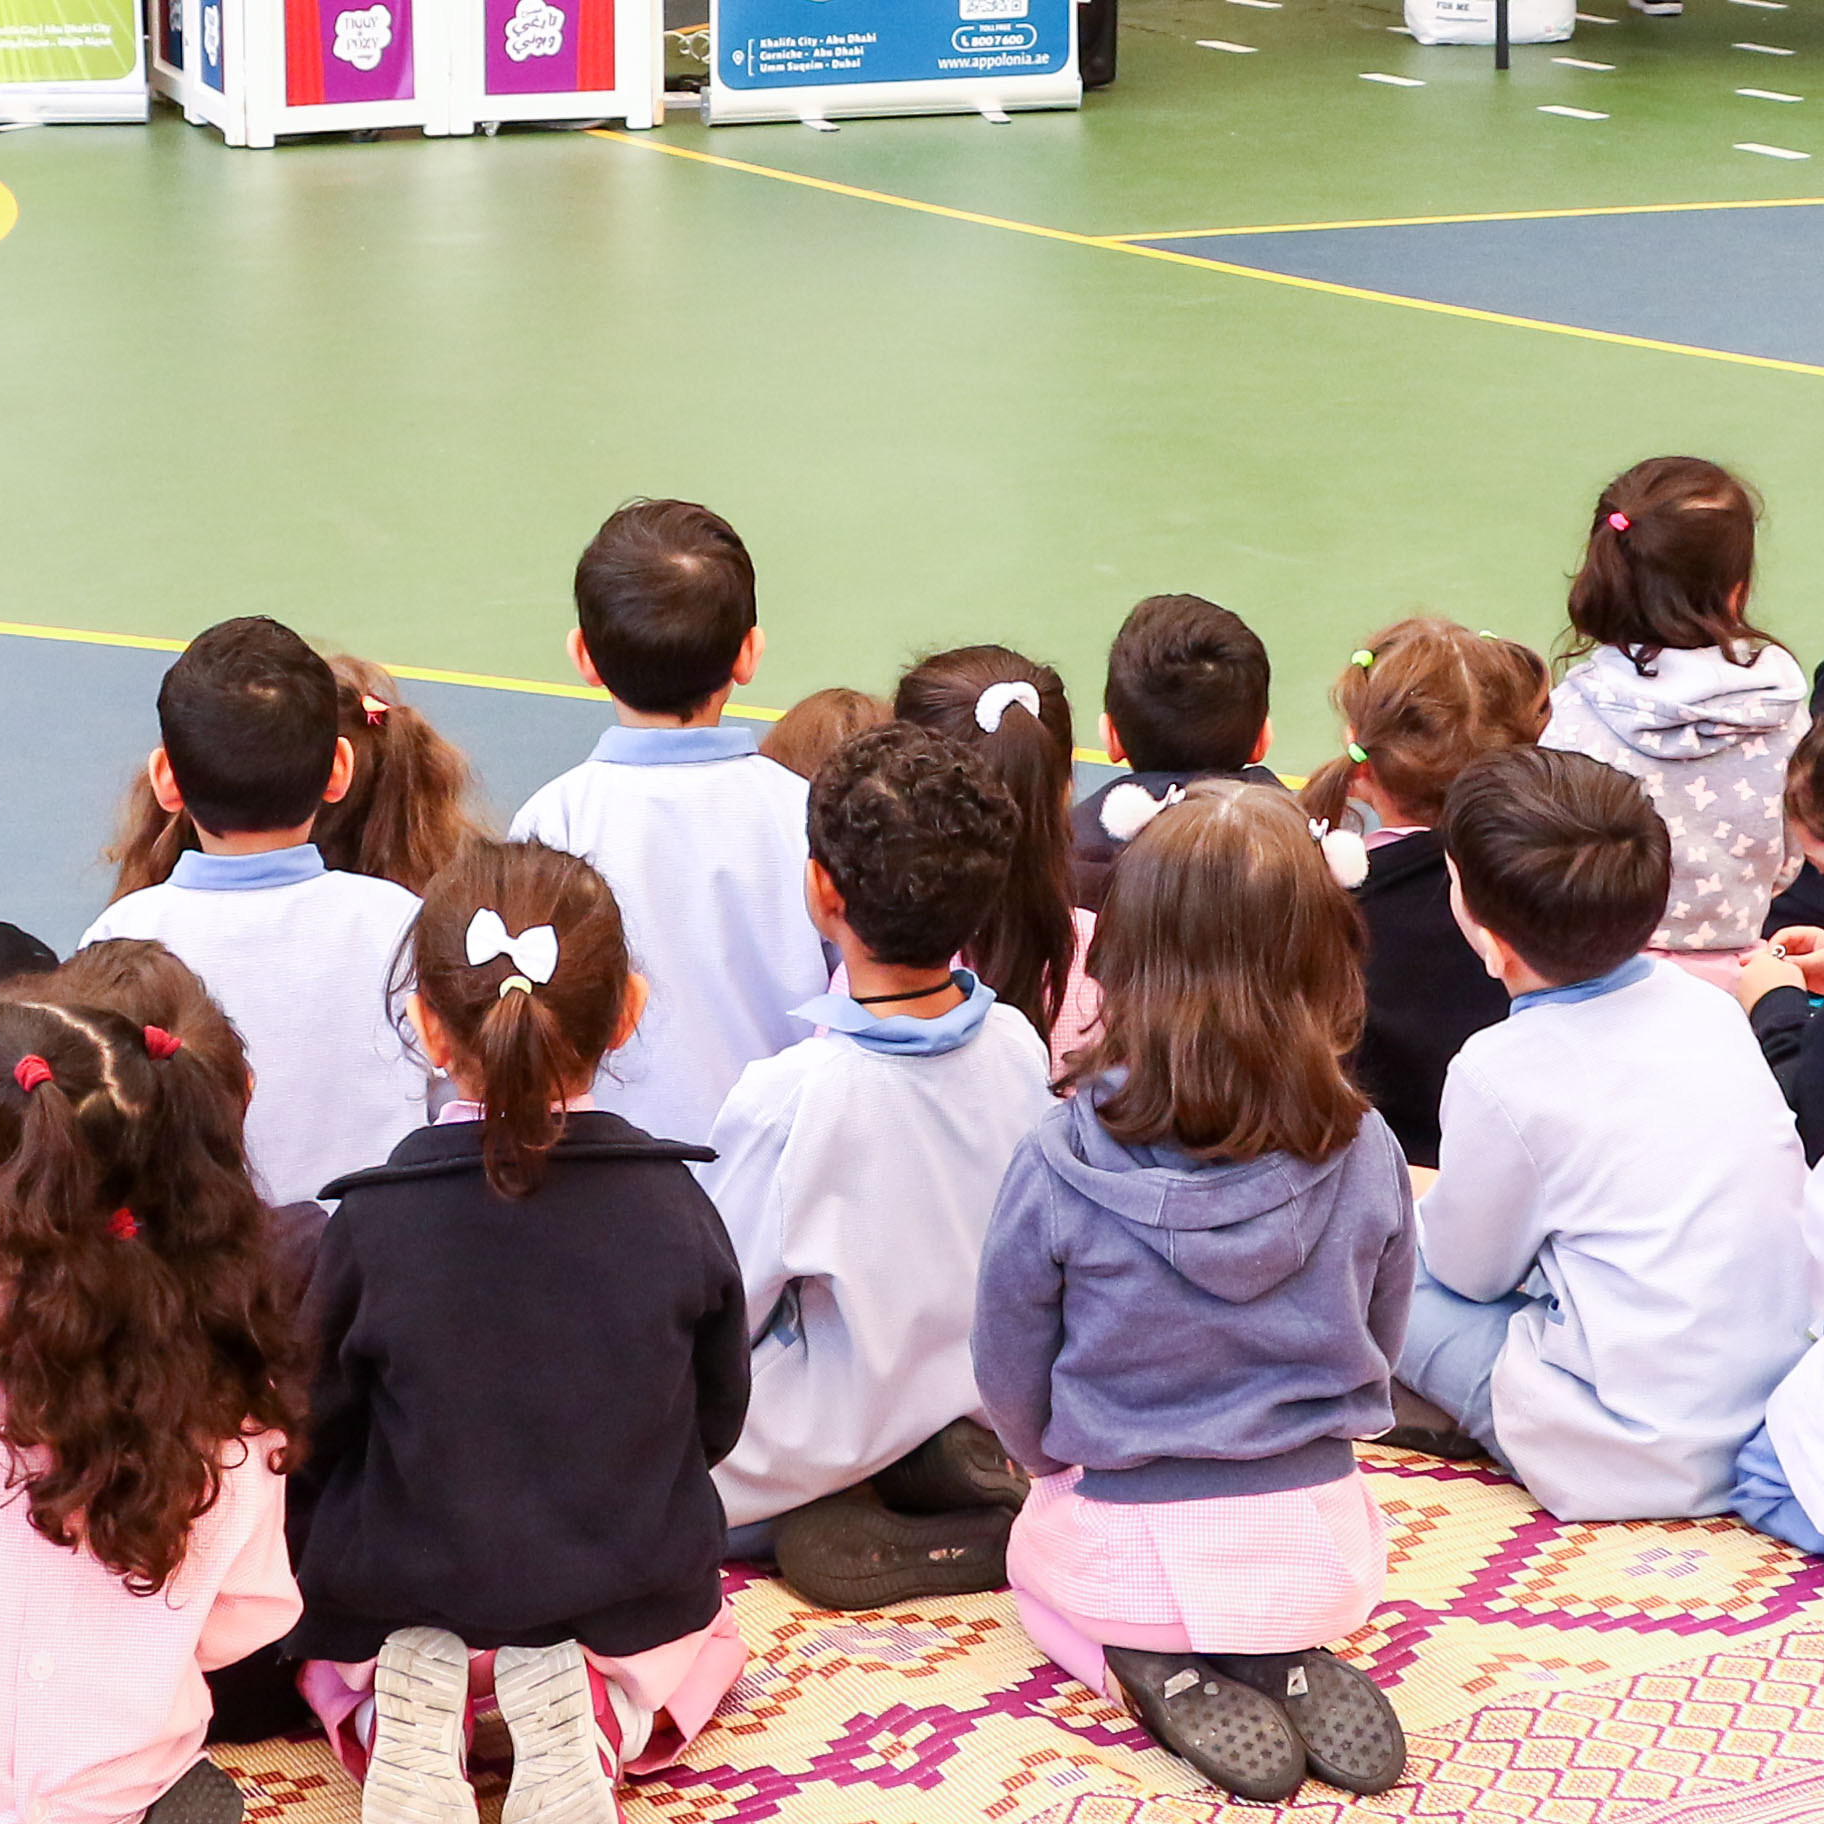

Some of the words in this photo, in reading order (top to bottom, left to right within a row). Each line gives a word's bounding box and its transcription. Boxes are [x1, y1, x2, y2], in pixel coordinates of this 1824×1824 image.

[759, 37, 797, 49] Khalifa
[798, 36, 819, 49] City
[825, 35, 846, 46] Abu
[847, 32, 877, 44] Dhabi
[759, 49, 803, 62] Corniche
[813, 47, 834, 58] Abu
[835, 45, 865, 57] Dhabi
[938, 51, 1050, 72] www.appolonia.ae
[759, 62, 785, 74] Umm
[831, 58, 862, 69] Dubai
